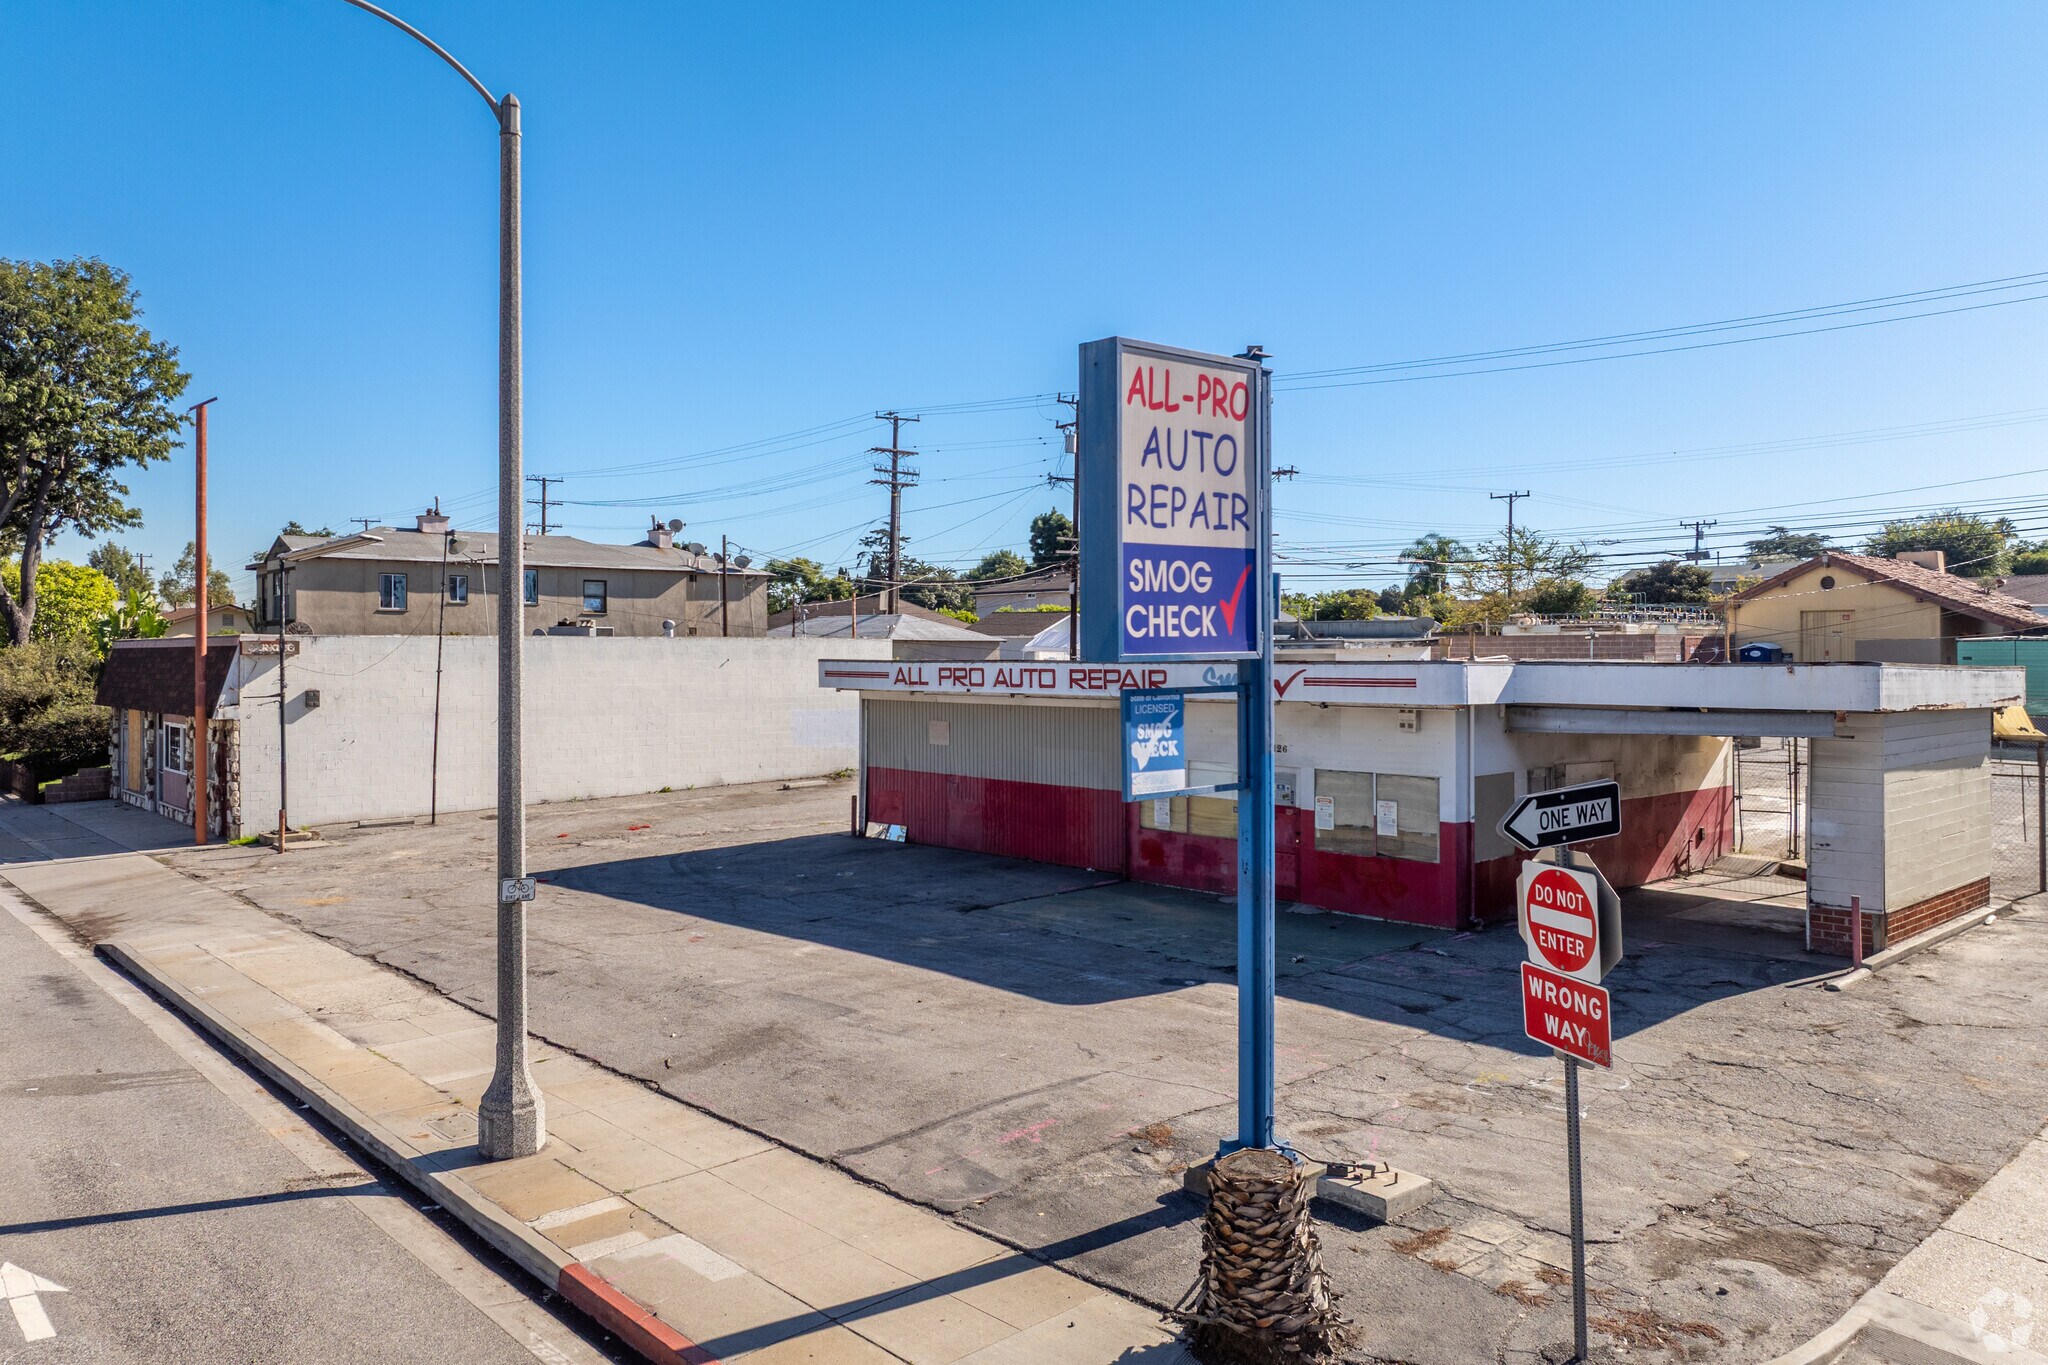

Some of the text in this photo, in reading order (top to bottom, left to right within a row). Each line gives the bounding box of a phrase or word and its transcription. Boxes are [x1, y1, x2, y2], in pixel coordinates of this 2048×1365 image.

[1127, 366, 1249, 422] ALL-PRO
[1141, 426, 1238, 477] AUTO
[1128, 483, 1250, 532] REPAIR
[1129, 558, 1213, 594] SMOG
[1126, 604, 1218, 638] CHECK
[893, 666, 930, 686] ALL
[938, 667, 985, 687] PRO
[993, 668, 1057, 688] AUTO
[1069, 668, 1168, 690] REPAIR
[1134, 703, 1176, 714] LICENSED
[1137, 722, 1173, 739] SMOG
[1539, 800, 1608, 831] ONE WAY
[1535, 883, 1584, 912] DO NOT
[1539, 928, 1585, 959] ENTER
[1528, 973, 1602, 1020] WRONG
[1544, 1012, 1588, 1048] WAY
